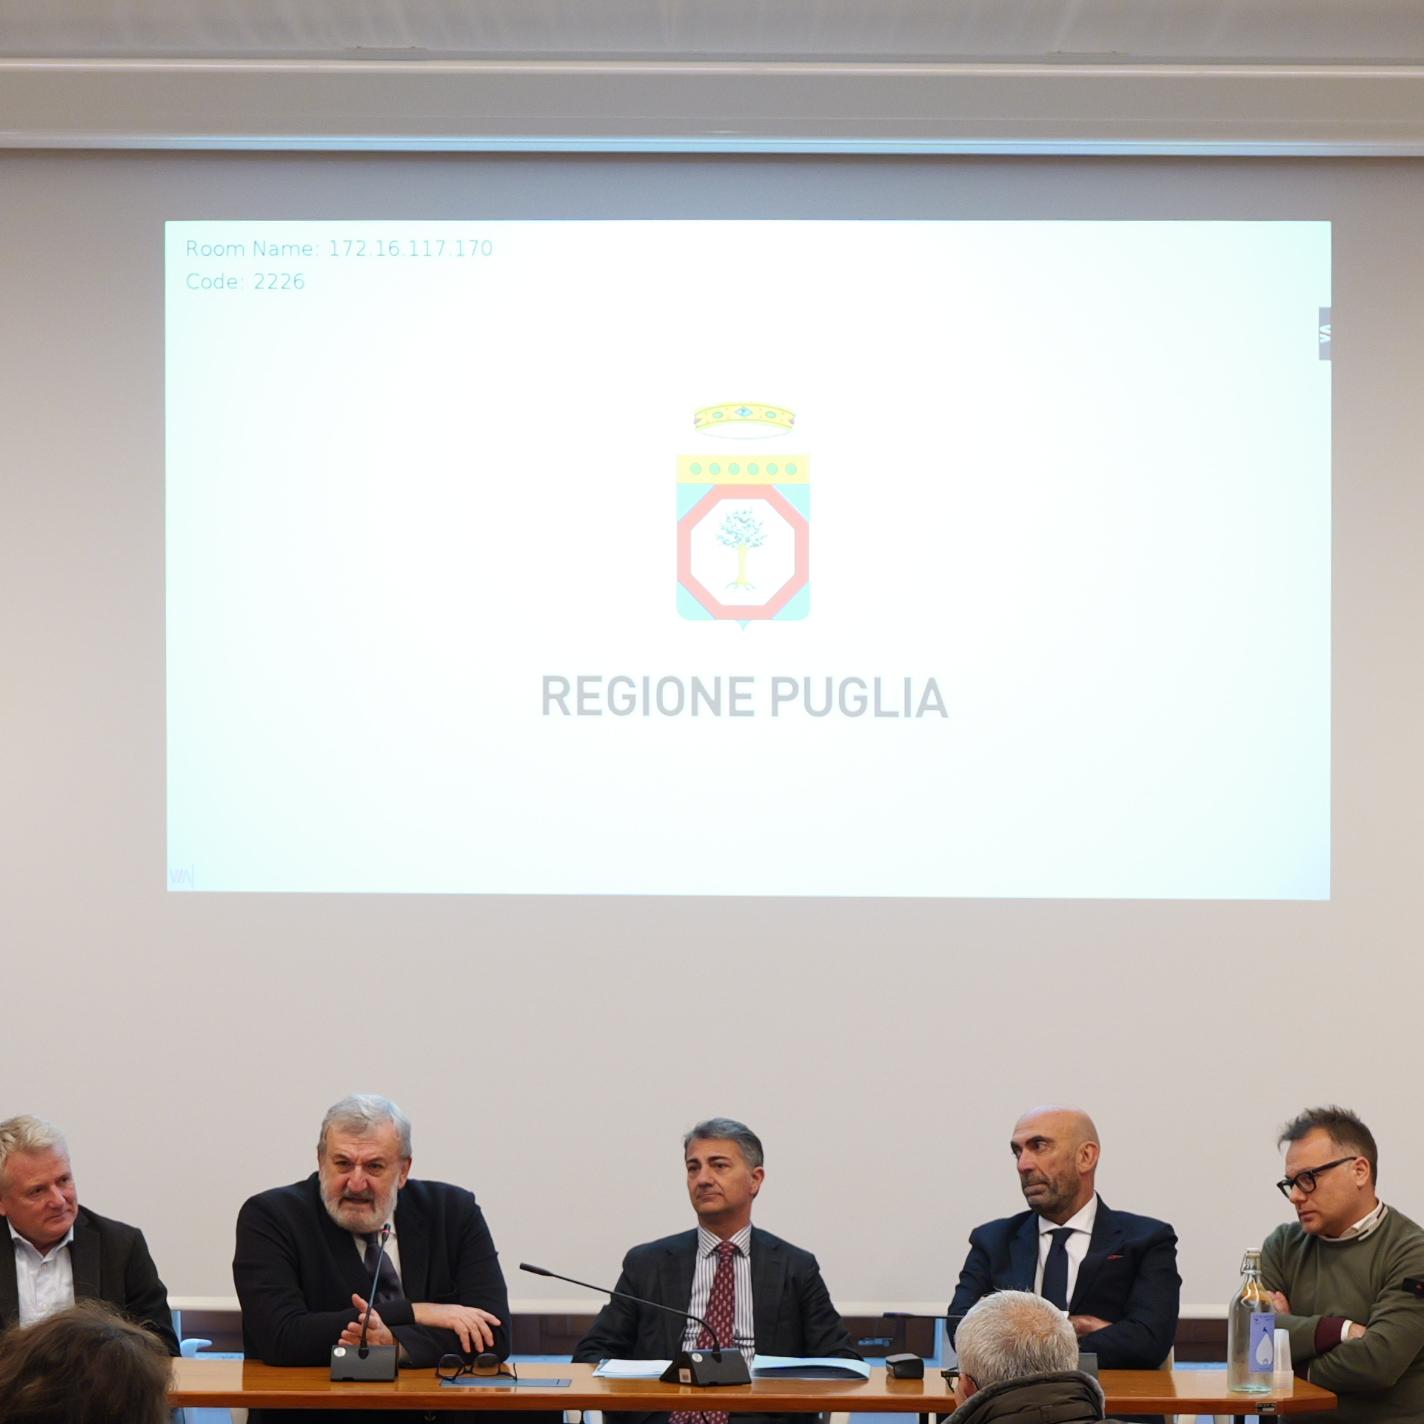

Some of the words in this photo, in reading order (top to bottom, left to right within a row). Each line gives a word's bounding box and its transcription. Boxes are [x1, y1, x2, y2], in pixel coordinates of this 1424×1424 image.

[186, 239, 245, 257] Room
[253, 239, 320, 257] Name:
[328, 239, 494, 257] 172.16.117.170
[186, 271, 244, 290] Code:
[254, 272, 306, 290] 2226
[541, 675, 756, 717] REGIONE
[770, 676, 949, 718] PUGLIA
